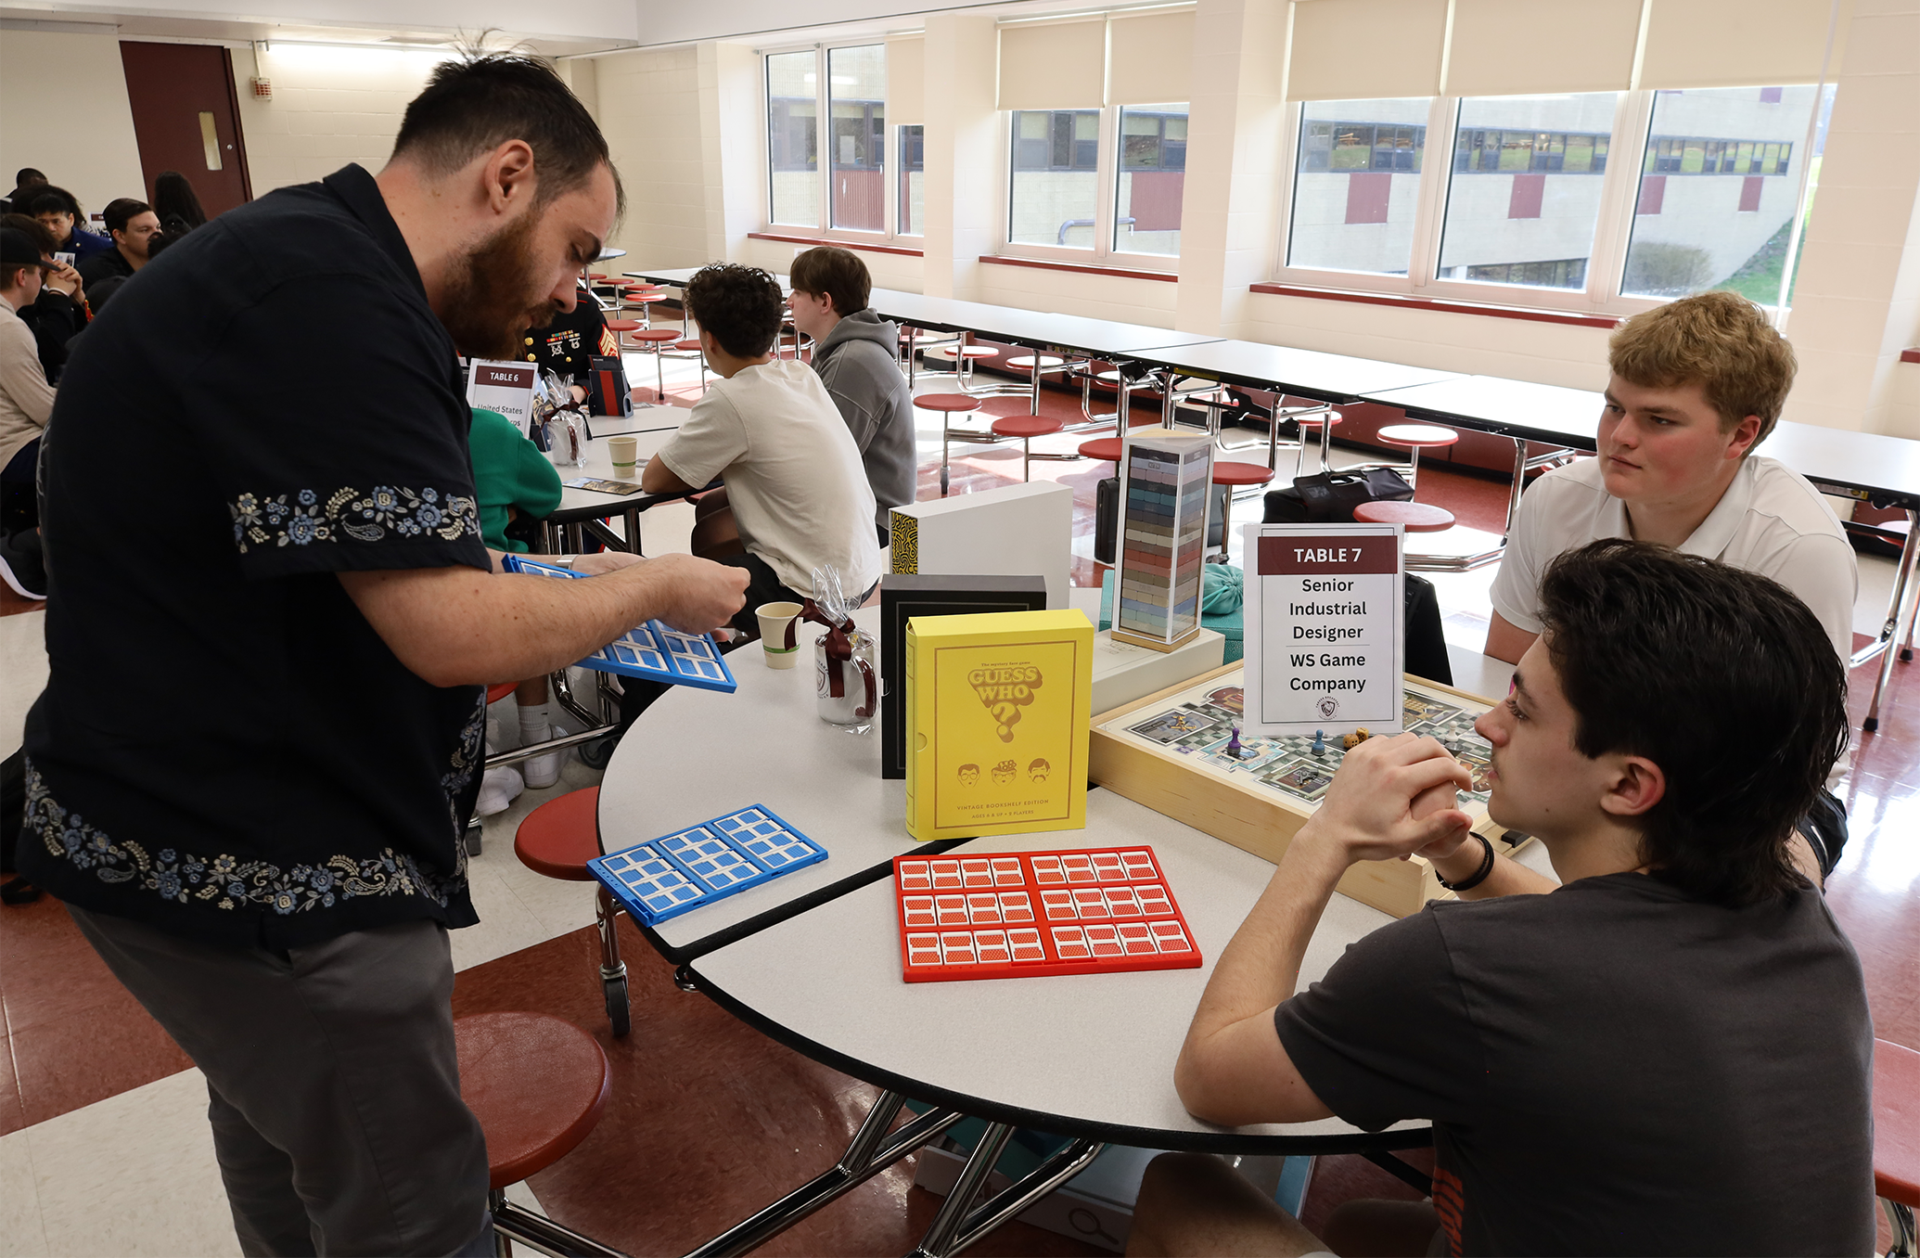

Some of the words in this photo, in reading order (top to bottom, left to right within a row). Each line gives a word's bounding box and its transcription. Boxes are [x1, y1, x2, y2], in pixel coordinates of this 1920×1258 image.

[490, 372, 513, 382] TABLE
[513, 374, 519, 382] 6
[501, 406, 523, 415] States
[1293, 548, 1347, 563] TABLE
[1351, 548, 1362, 563] 7
[1302, 578, 1354, 592] Senior
[1290, 601, 1367, 616] Industrial
[1293, 625, 1364, 642] Designer
[1290, 653, 1316, 667] WS
[1320, 653, 1366, 667] Game
[968, 666, 1041, 686] GUESS
[1290, 677, 1366, 693] Company
[976, 683, 1031, 703] WHO
[986, 801, 1021, 809] BOOKSHELF
